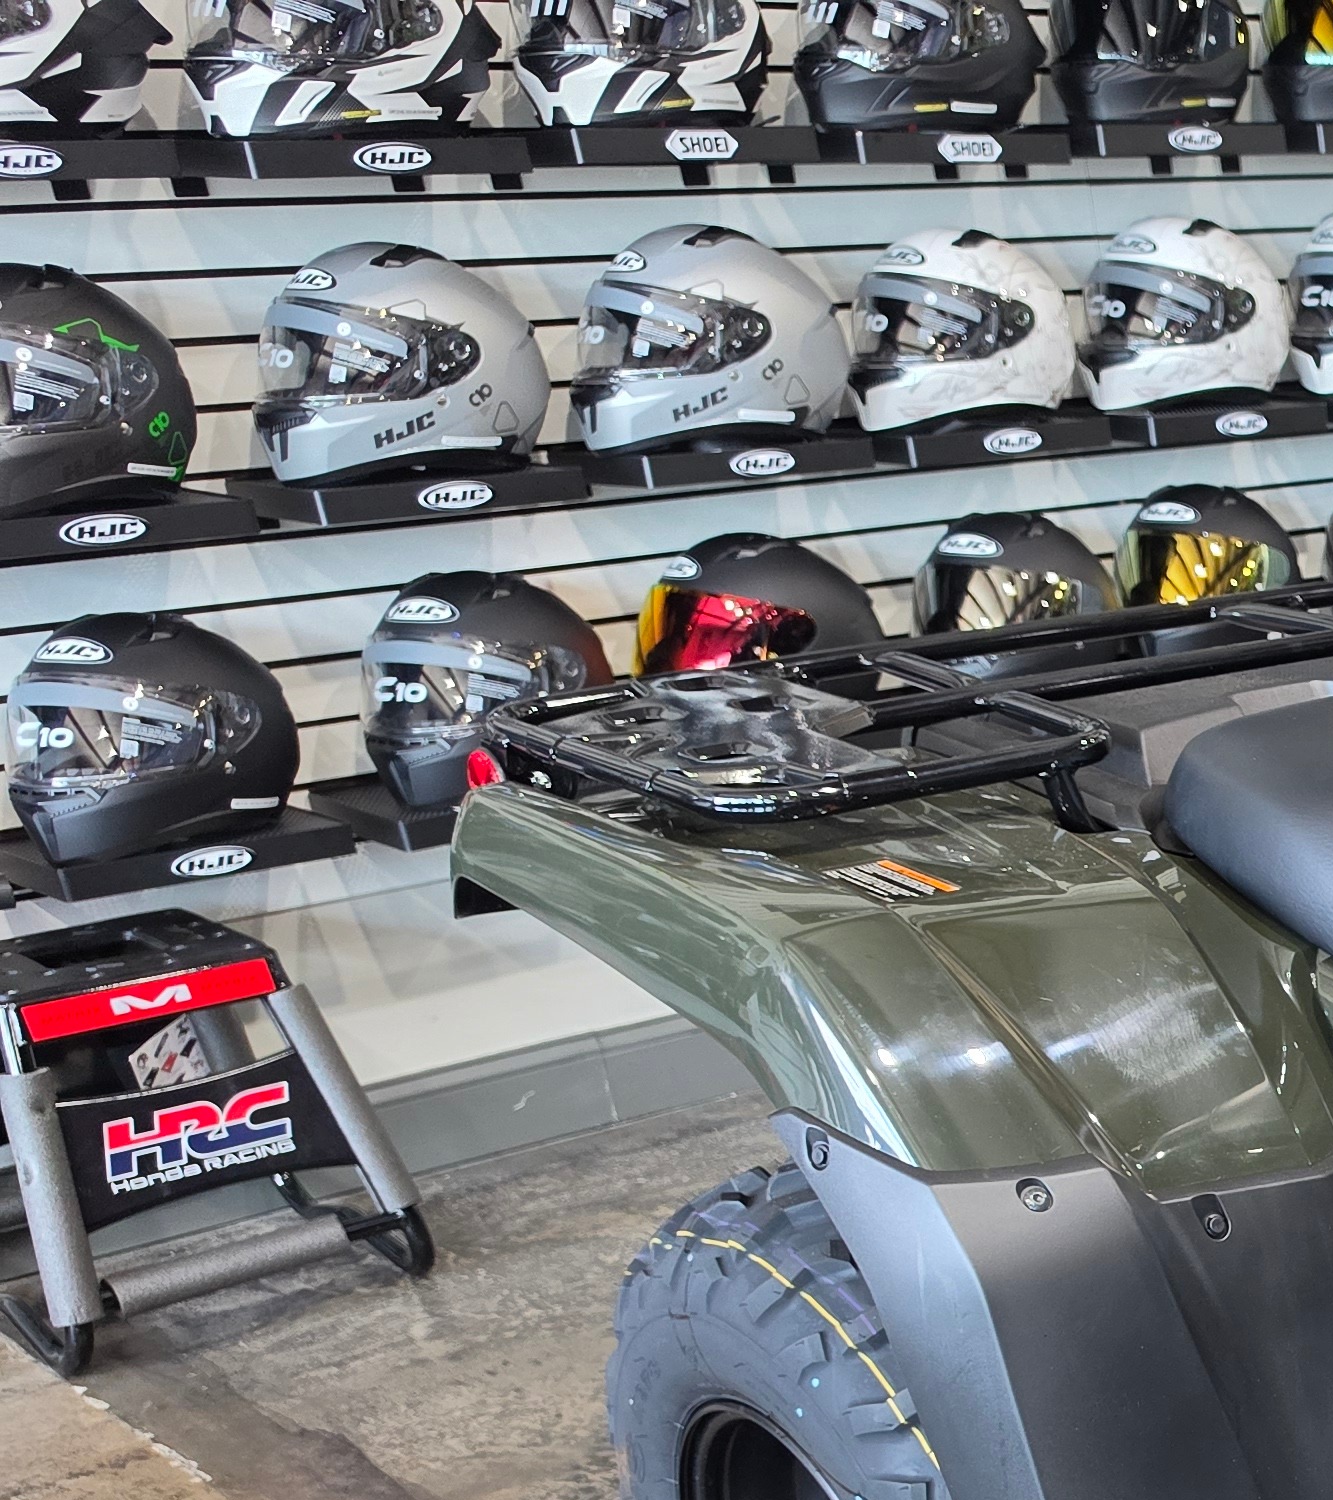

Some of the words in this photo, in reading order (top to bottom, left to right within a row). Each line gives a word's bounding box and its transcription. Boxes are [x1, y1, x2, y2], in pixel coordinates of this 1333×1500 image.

[680, 136, 729, 153] SHOEI
[951, 138, 994, 156] SHOEI
[371, 151, 425, 165] HJC
[762, 357, 785, 381] C10
[468, 383, 493, 408] C10
[672, 386, 729, 423] HJC
[149, 411, 170, 438] C10
[373, 411, 436, 449] HJC
[745, 456, 789, 469] HJC
[434, 488, 486, 503] HJC
[77, 522, 138, 539] HJC
[40, 641, 106, 661] HJC
[374, 675, 428, 704] C10
[15, 721, 74, 749] C10
[188, 852, 246, 872] HJC
[103, 1081, 292, 1182] HRC
[110, 1164, 201, 1195] Honda
[204, 1139, 296, 1171] RACING
